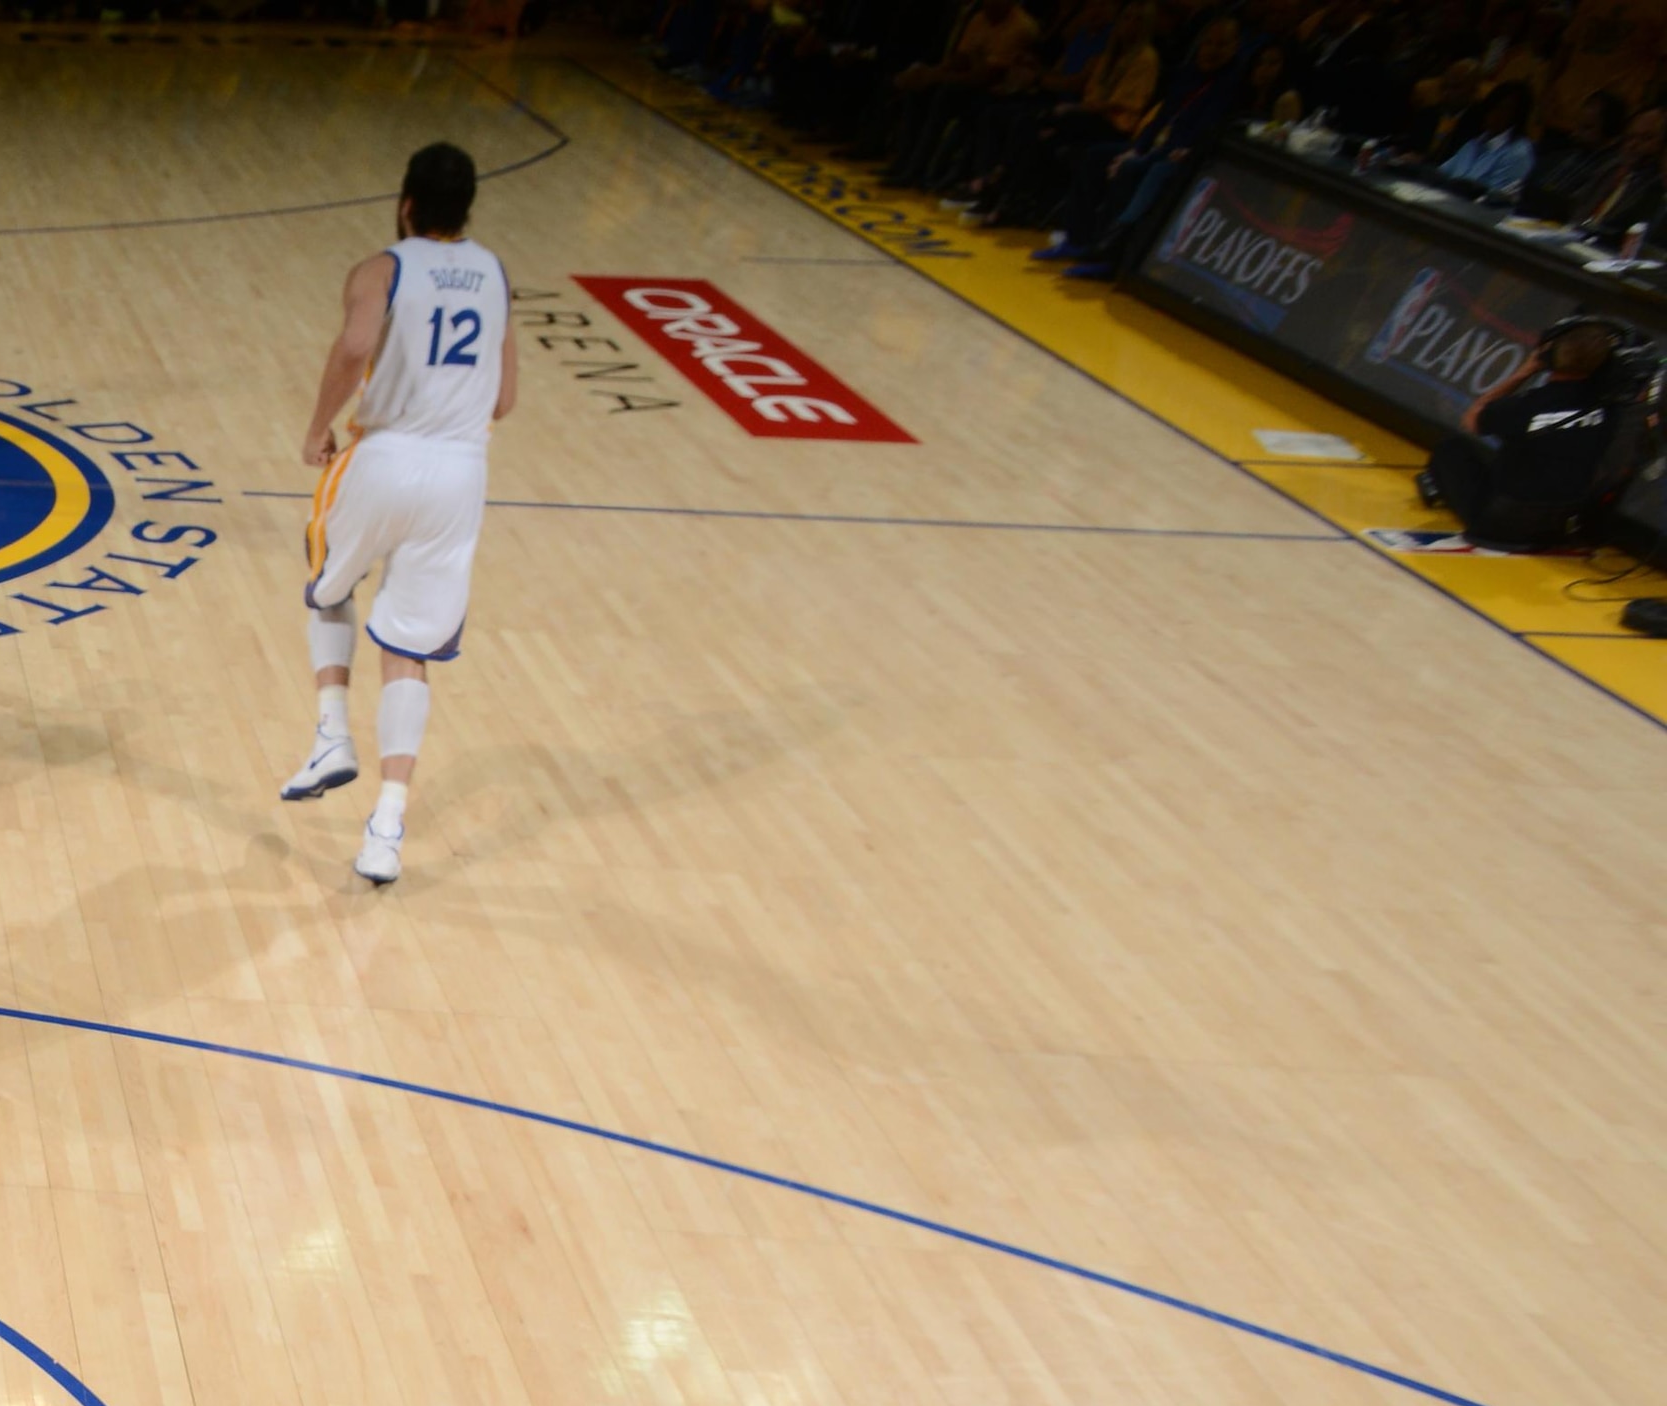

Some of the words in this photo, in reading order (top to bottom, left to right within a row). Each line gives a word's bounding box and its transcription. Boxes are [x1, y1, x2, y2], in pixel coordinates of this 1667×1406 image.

[1178, 206, 1326, 305] PLAYOFFS
[427, 306, 481, 367] 12
[512, 288, 681, 414] ARENA
[622, 286, 858, 426] ORACLE
[1393, 303, 1549, 397] PLAYO
